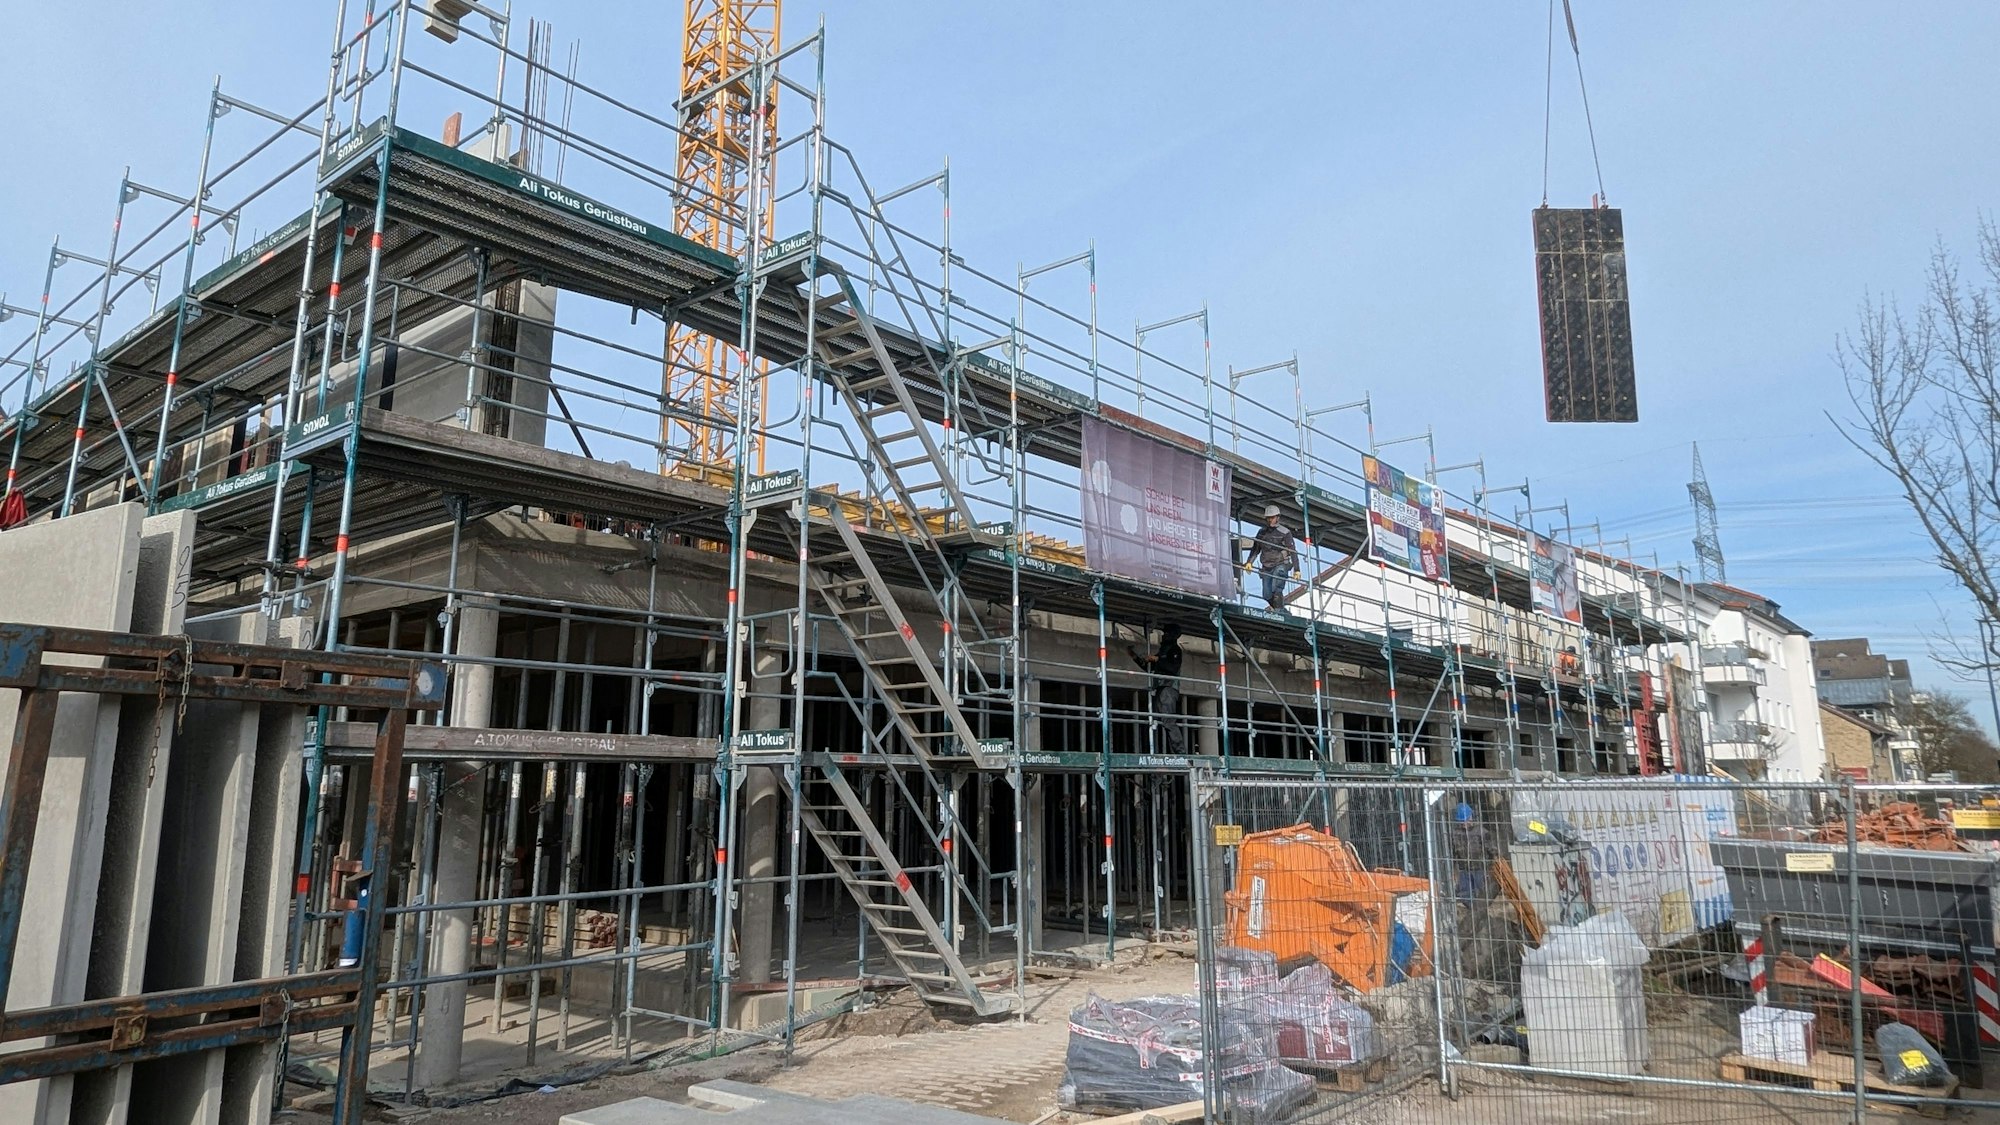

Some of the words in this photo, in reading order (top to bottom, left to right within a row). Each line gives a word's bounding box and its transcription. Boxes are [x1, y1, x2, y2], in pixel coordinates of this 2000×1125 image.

[336, 134, 364, 161] TOKUS
[519, 177, 538, 193] Ali
[541, 184, 580, 210] Tokus
[584, 201, 647, 235] Gerüstbau
[766, 245, 779, 260] Ali
[780, 236, 807, 254] Tokus
[987, 358, 998, 370] Ali
[999, 362, 1020, 379] Toks
[1020, 370, 1054, 392] Gerüstbau
[303, 413, 330, 436] TOKUS
[1211, 465, 1220, 478] W
[205, 485, 217, 499] Ali
[216, 478, 234, 496] Tokus
[234, 470, 268, 490] Gerüstbau
[749, 480, 763, 494] Ali
[764, 474, 792, 491] Tokus
[1145, 487, 1170, 504] SCHAU
[740, 734, 754, 747] Ali
[755, 733, 784, 747] Tokus
[1025, 753, 1061, 764] Gerüstbau
